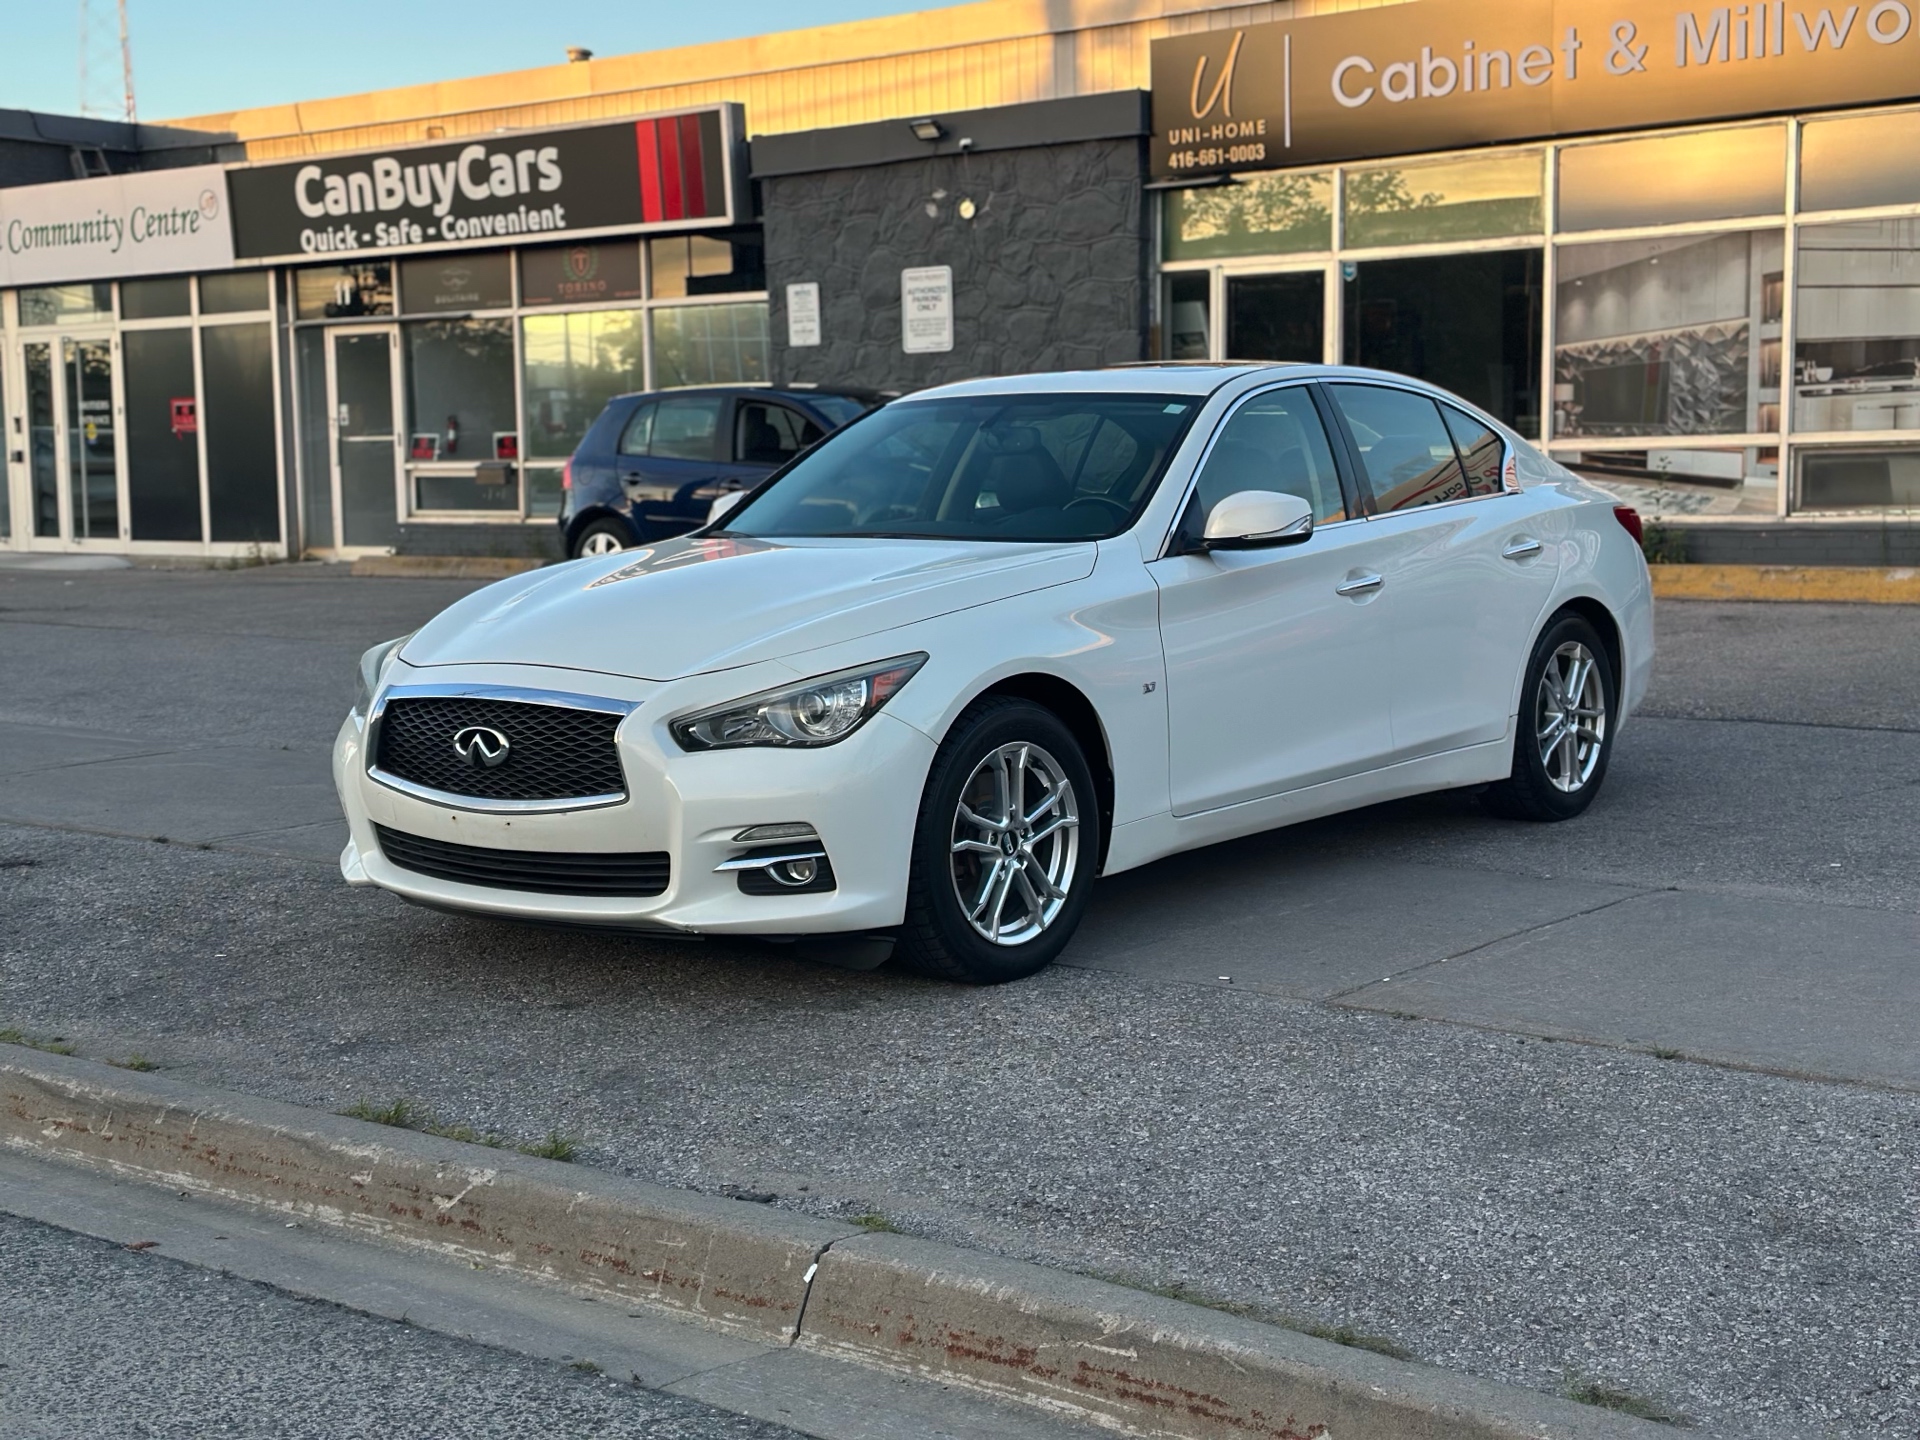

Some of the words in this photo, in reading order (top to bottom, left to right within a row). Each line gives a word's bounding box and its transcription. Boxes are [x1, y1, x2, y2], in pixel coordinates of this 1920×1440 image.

[1331, 27, 1582, 108] Cabinet
[1604, 20, 1648, 75] &
[1675, 0, 1920, 67] Millwo
[1168, 119, 1267, 145] UNI-HOME
[1168, 143, 1266, 170] 416-661-0003
[294, 144, 562, 218] CanBuyCars
[8, 209, 124, 254] Community
[130, 206, 201, 243] Centre
[300, 224, 359, 253] Quick
[375, 218, 423, 247] Safe
[441, 203, 566, 240] Convenient
